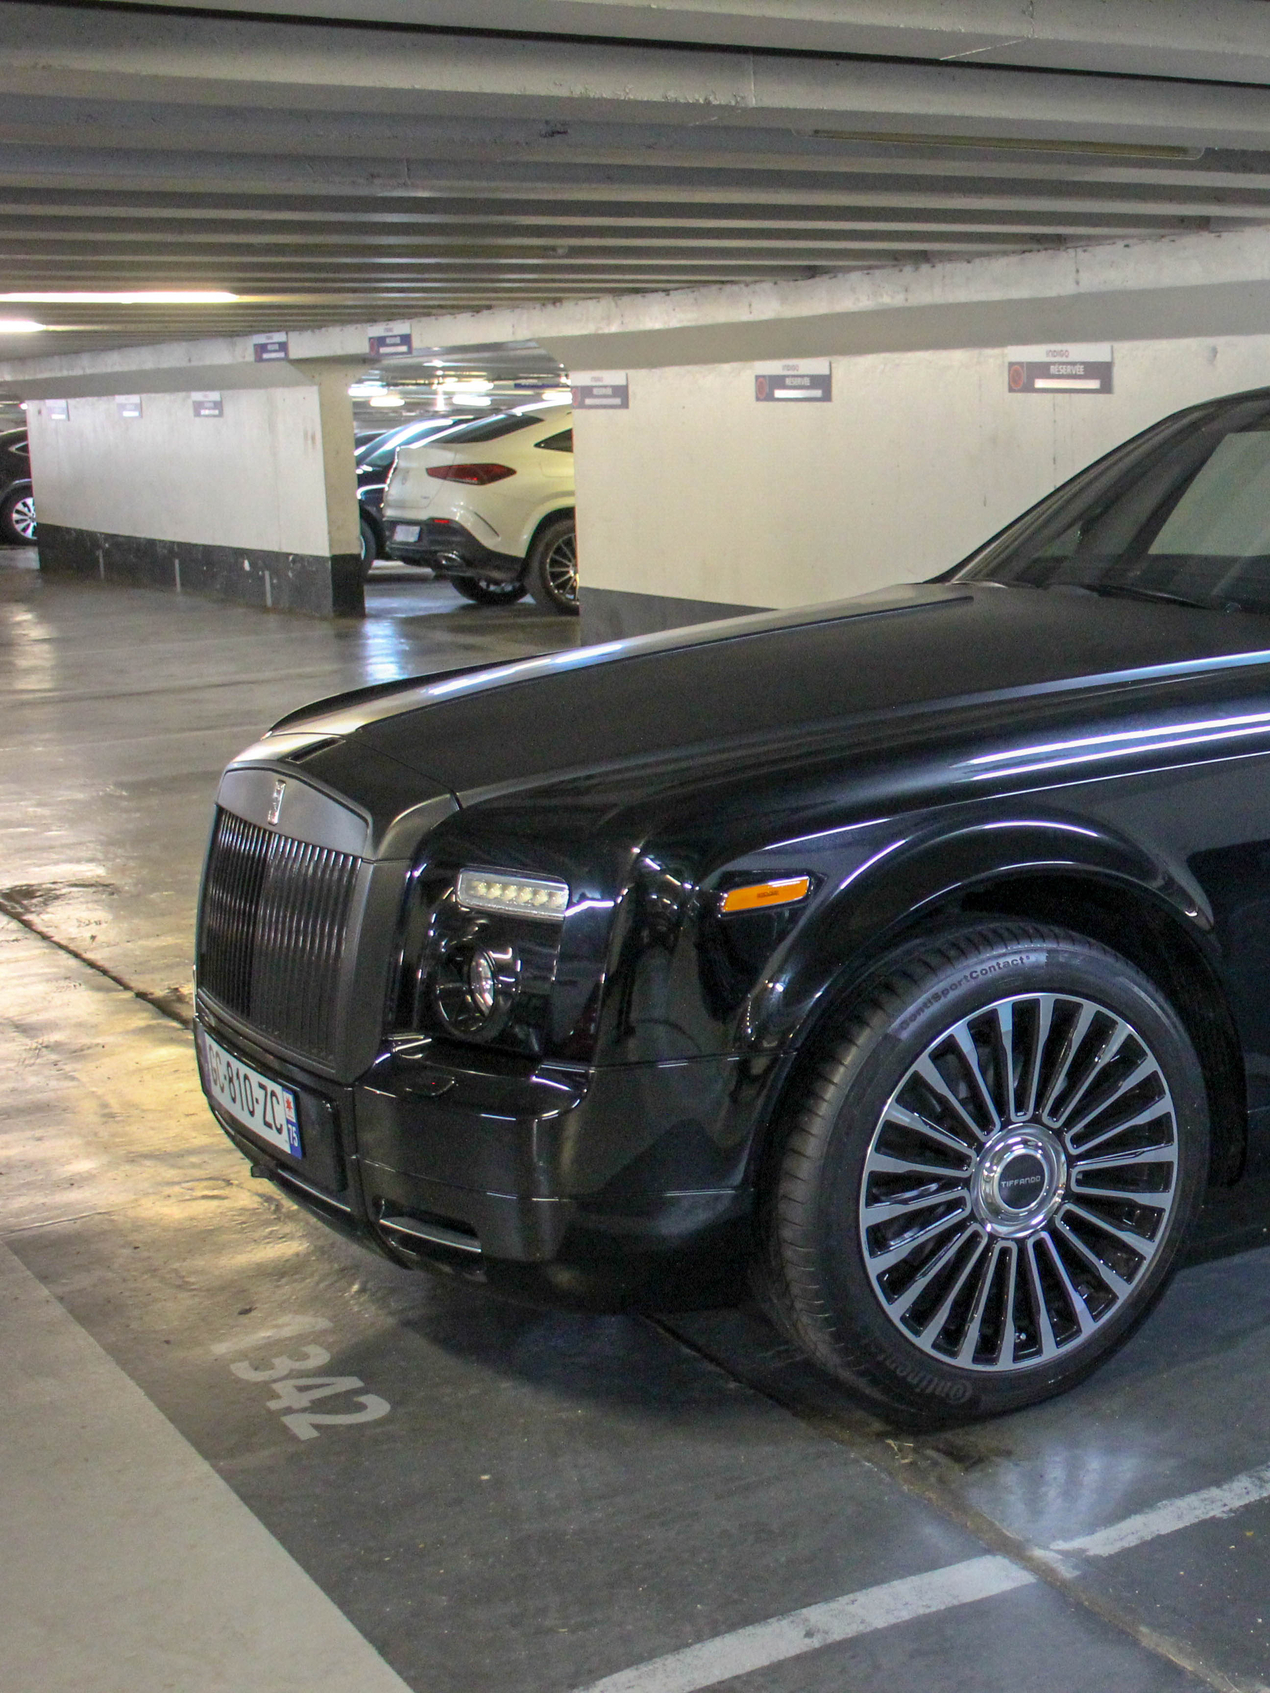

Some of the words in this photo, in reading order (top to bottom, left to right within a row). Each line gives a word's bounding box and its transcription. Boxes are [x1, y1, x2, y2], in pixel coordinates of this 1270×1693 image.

[1045, 349, 1070, 359] INDIGO
[1049, 364, 1085, 375] RÉSERVÉE
[899, 955, 1026, 1031] ContiSportContact
[208, 1043, 284, 1136] GC-810-ZC
[287, 1123, 299, 1147] 75
[208, 1314, 391, 1441] 1342
